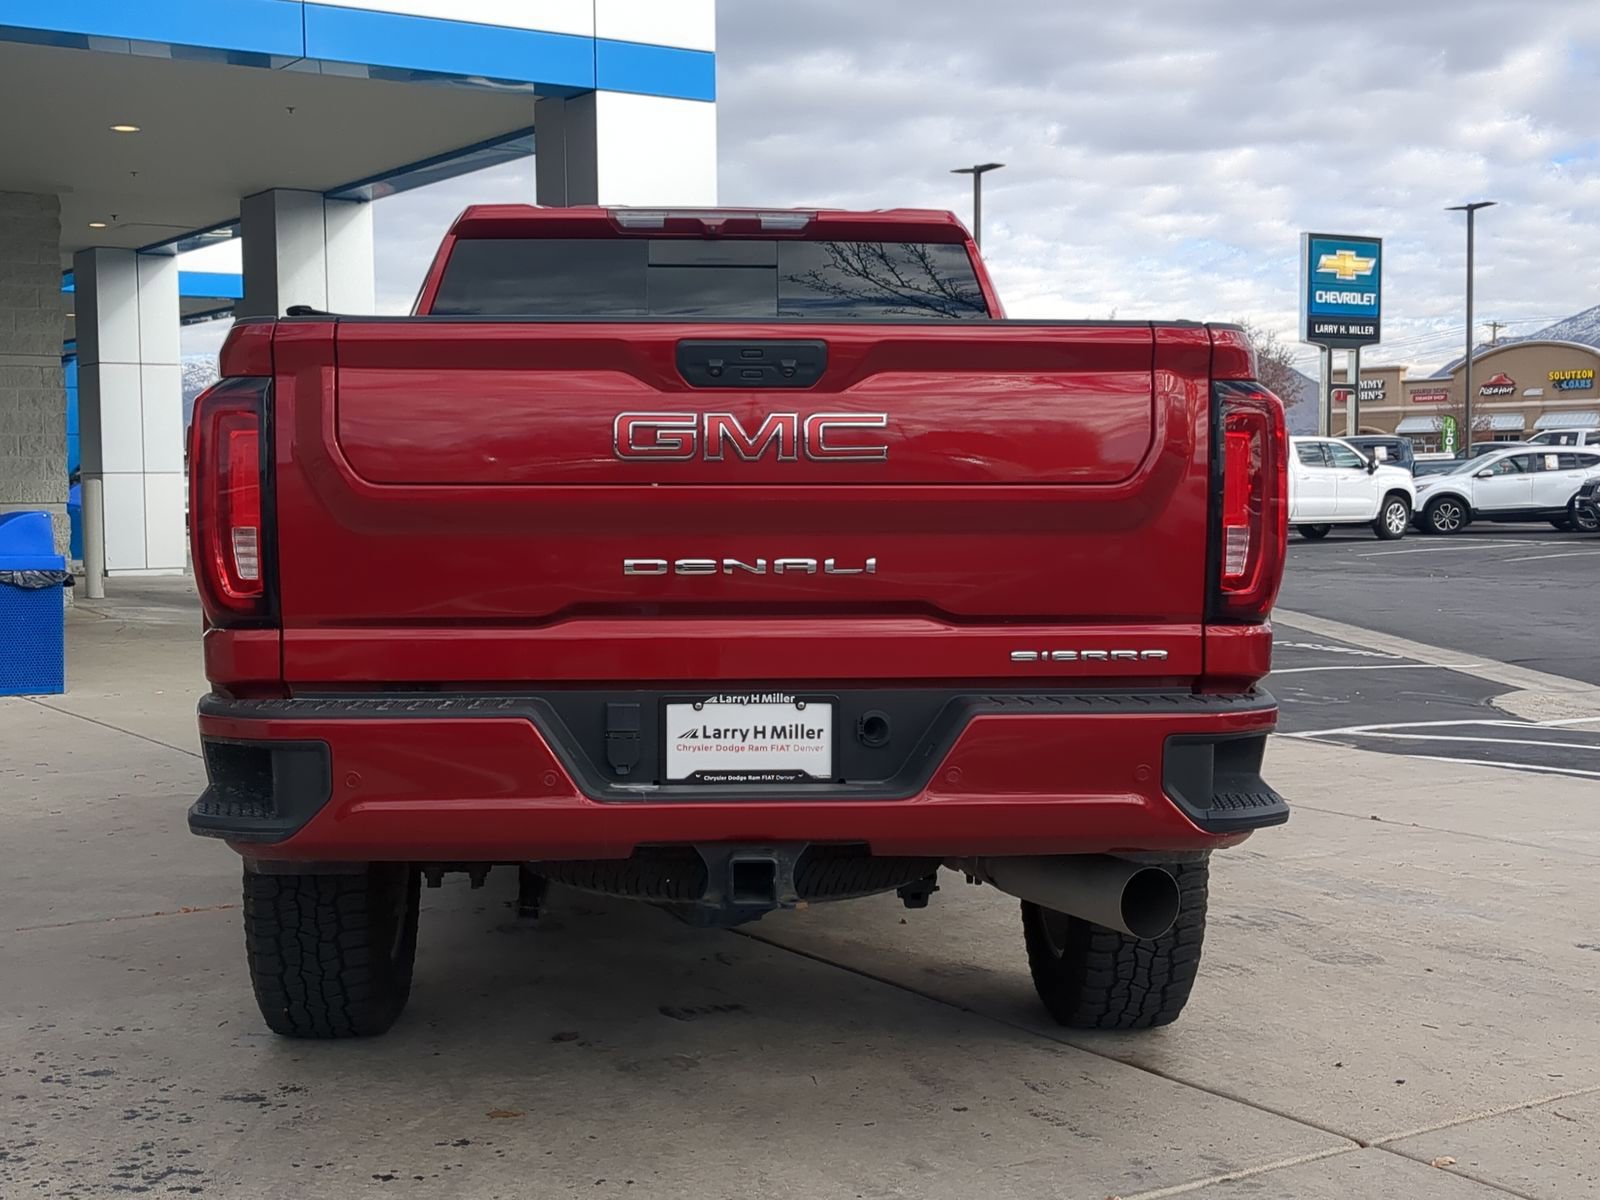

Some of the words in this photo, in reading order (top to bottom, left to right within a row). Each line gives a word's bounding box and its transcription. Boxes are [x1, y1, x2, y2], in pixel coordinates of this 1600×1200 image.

[1316, 290, 1376, 305] CHEVROLET
[1315, 324, 1338, 334] LARRY
[1340, 325, 1347, 334] H.
[1349, 325, 1374, 335] MILLER
[1548, 369, 1594, 380] SOLUTION
[1359, 380, 1383, 389] MMY
[1359, 391, 1384, 400] HN'S
[613, 411, 888, 461] GMC
[1445, 428, 1454, 453] LOA
[624, 557, 876, 575] DENALI
[1011, 649, 1168, 661] SIERRA
[719, 694, 748, 705] Larry
[751, 694, 760, 703] H
[761, 693, 795, 704] Miller
[703, 725, 749, 742] Larry
[754, 725, 766, 739] H
[771, 724, 824, 739] Miller
[676, 743, 713, 753] Chrysler
[716, 743, 745, 753] Dodge
[748, 744, 768, 752] Ram
[771, 744, 790, 752] FIAT
[793, 744, 824, 752] Denver
